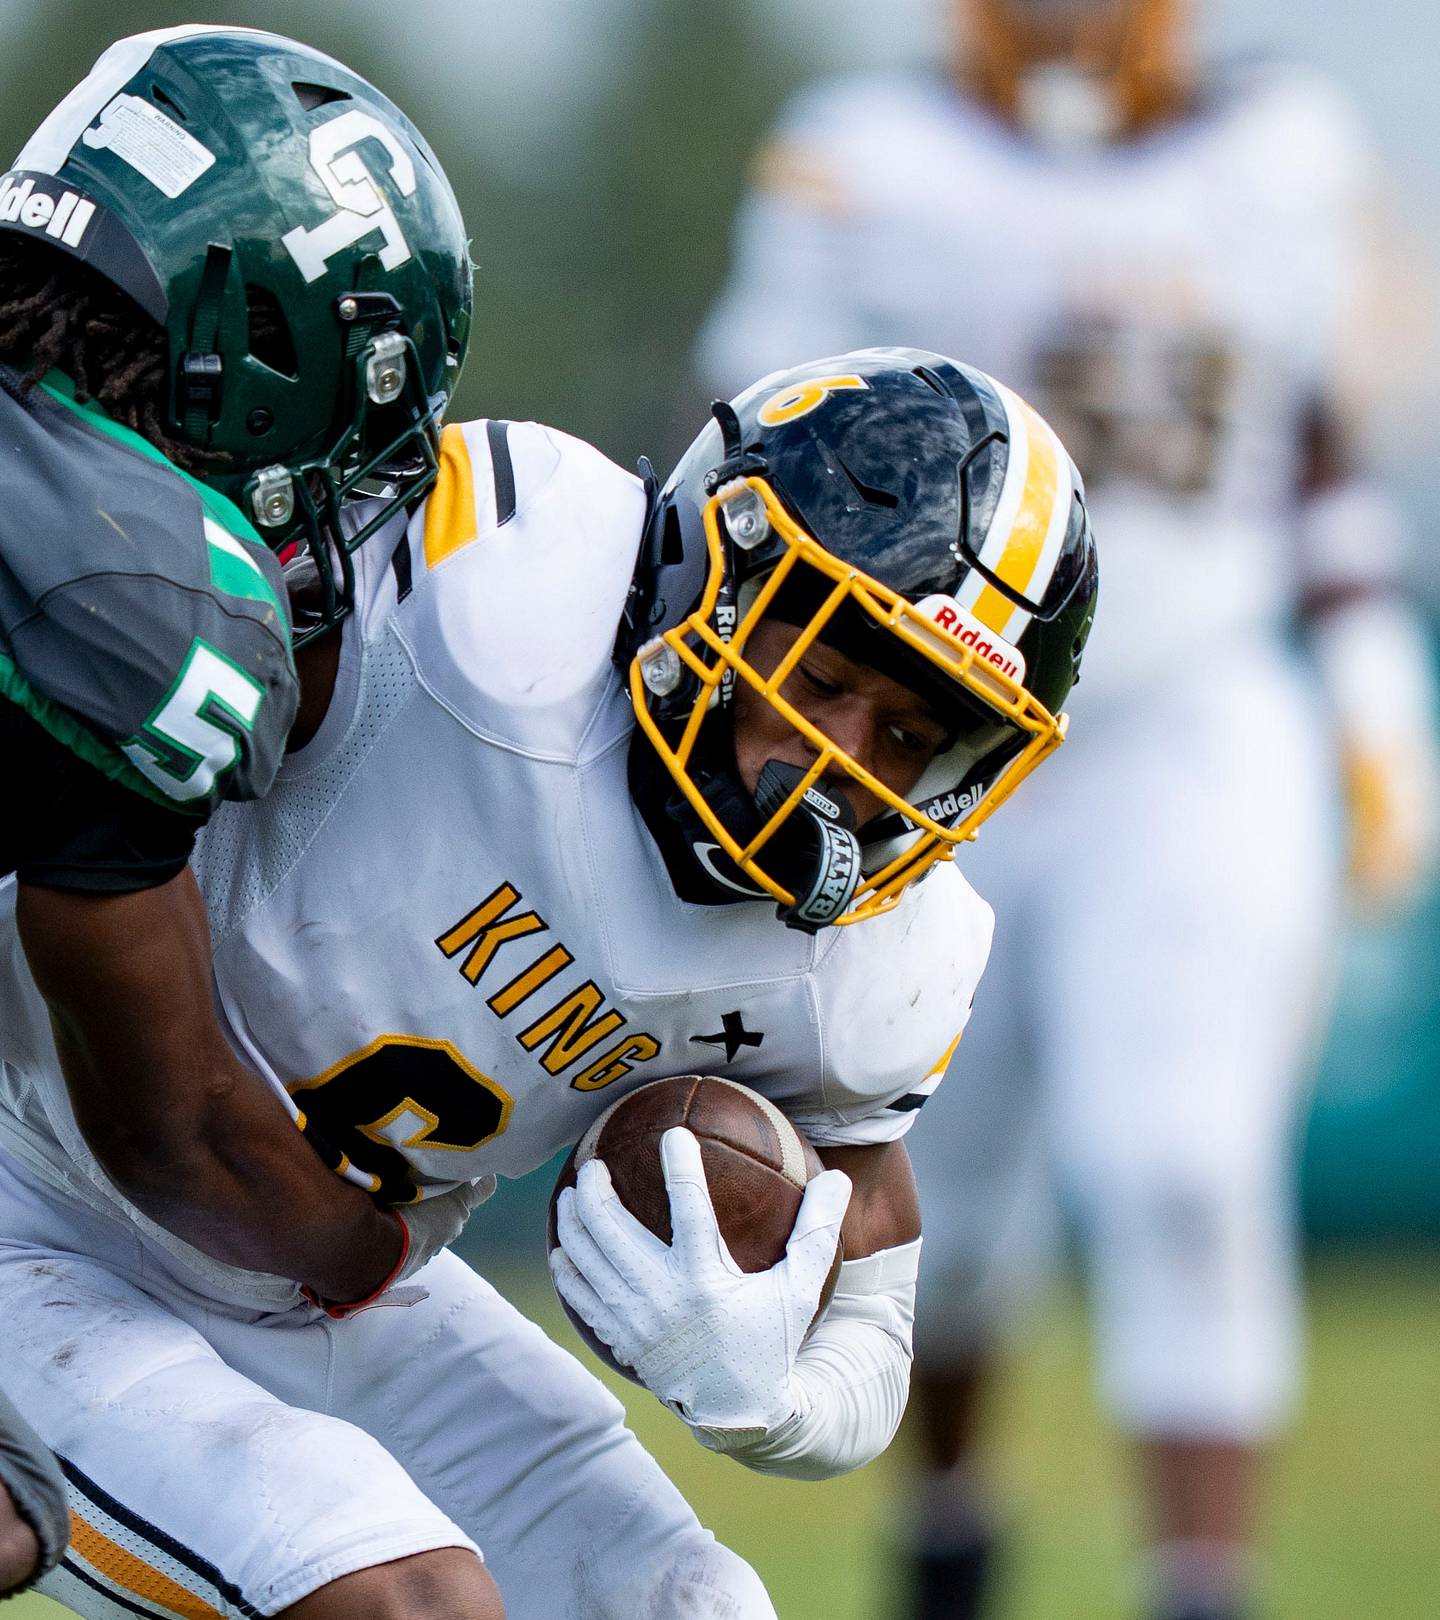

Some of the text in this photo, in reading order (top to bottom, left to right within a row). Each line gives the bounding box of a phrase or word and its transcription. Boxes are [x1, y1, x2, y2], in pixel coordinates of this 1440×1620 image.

[154, 114, 186, 140] WARNING
[716, 605, 737, 701] Riell
[934, 605, 1018, 678] Riddell
[120, 637, 266, 801] 5
[806, 826, 852, 917] BATTL
[434, 881, 661, 1092] KING
